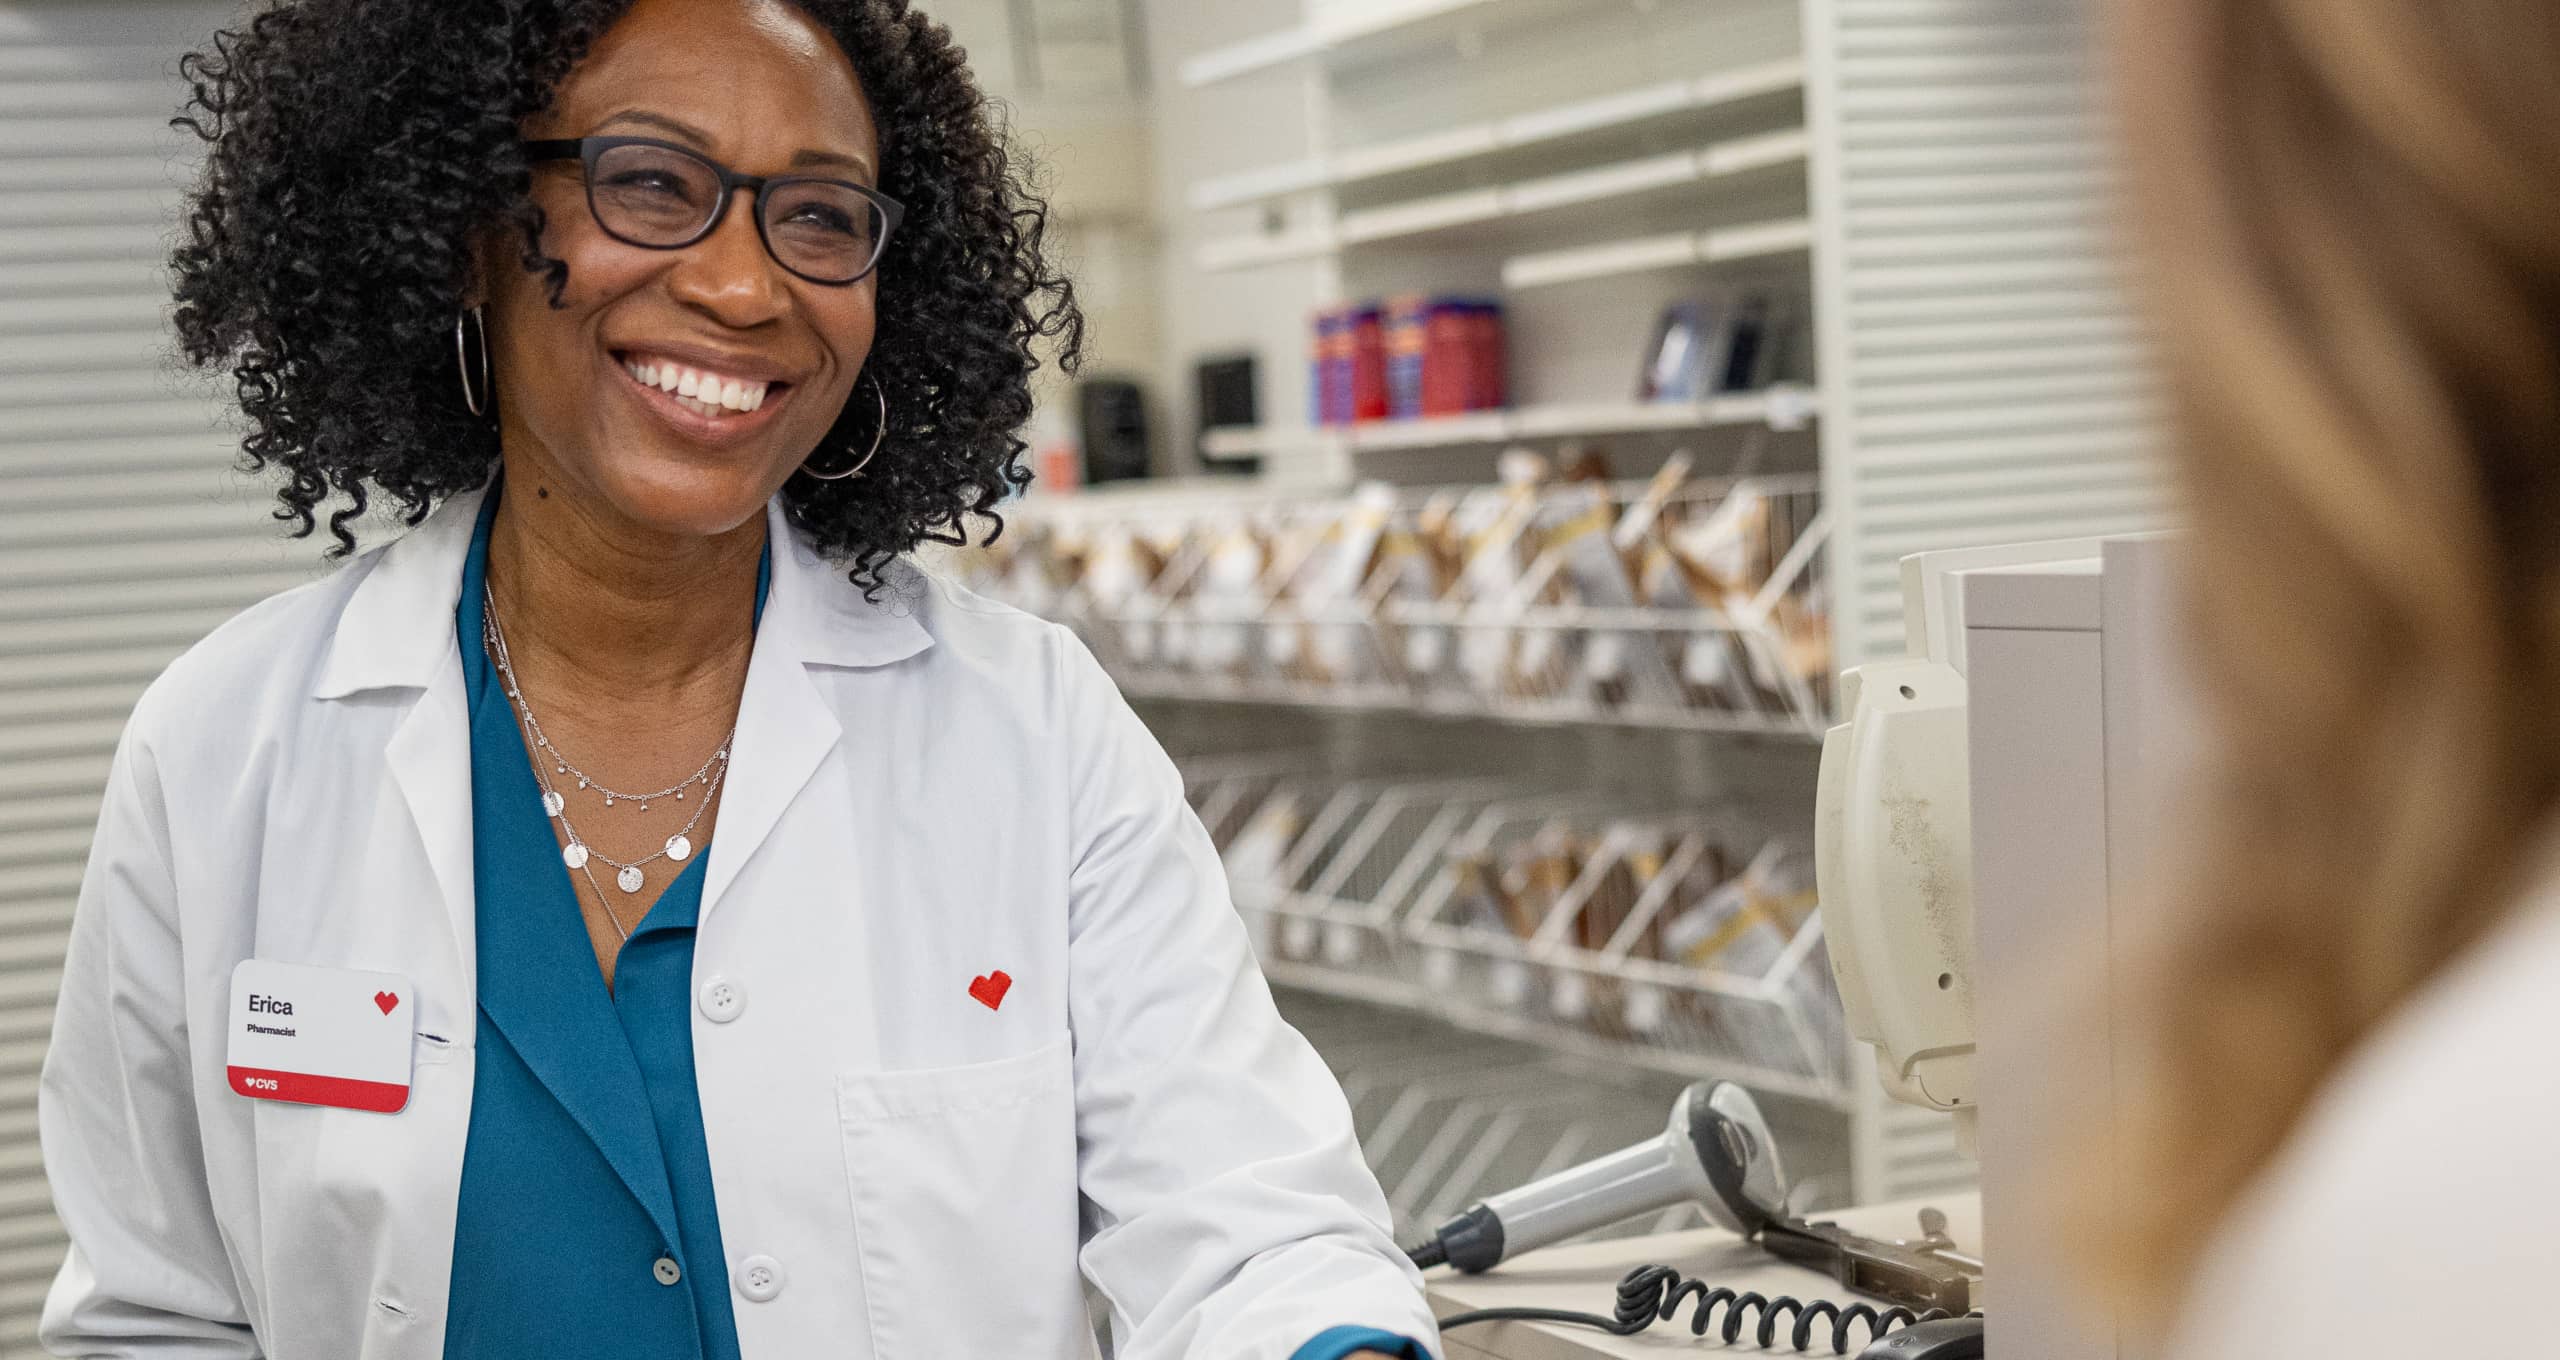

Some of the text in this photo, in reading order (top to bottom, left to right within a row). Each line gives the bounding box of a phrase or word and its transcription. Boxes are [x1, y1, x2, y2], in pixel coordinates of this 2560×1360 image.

[248, 994, 293, 1016] Erica
[247, 1023, 296, 1037] Pharmacist
[255, 1077, 278, 1090] CVS
